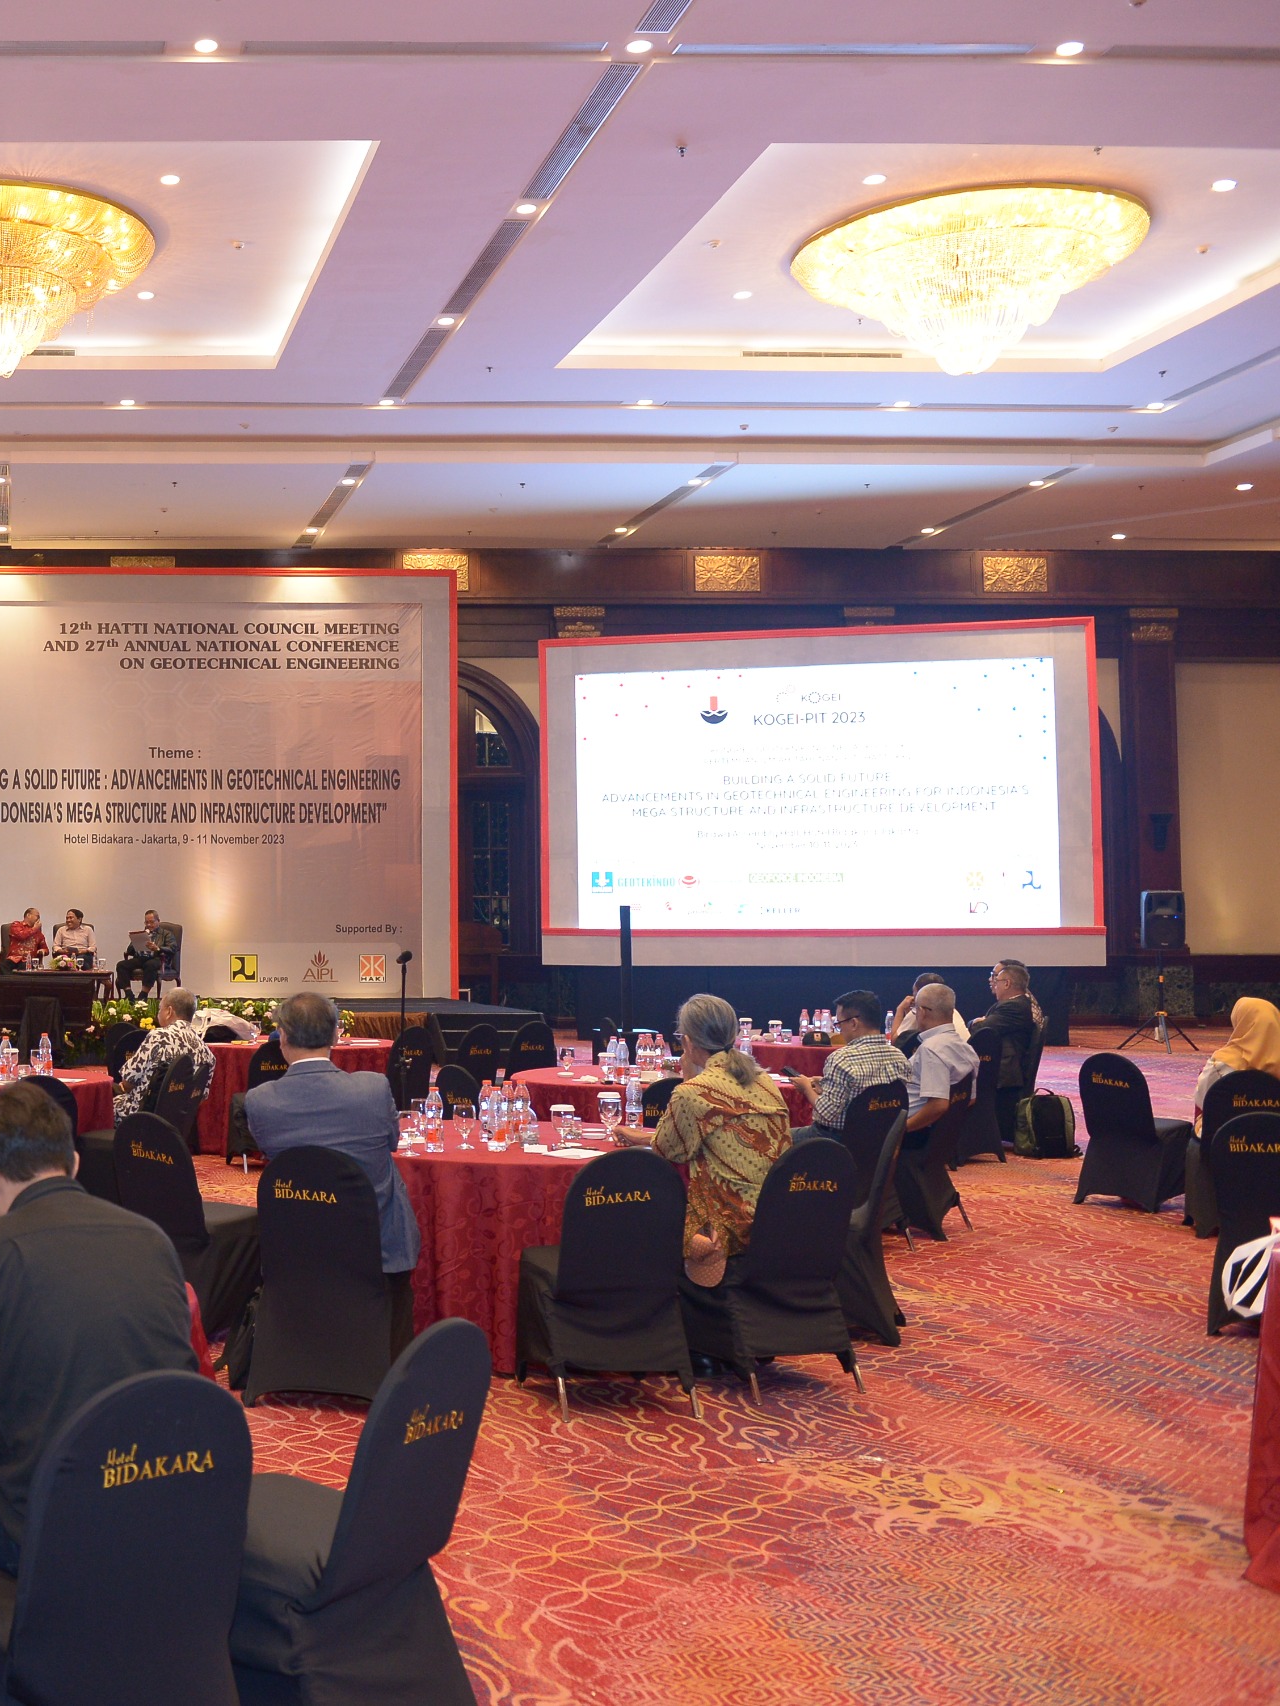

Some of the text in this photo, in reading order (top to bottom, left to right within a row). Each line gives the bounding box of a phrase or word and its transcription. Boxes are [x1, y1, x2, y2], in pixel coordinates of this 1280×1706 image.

[59, 621, 399, 635] 12th HATTI NATIONAL COUNCIL MEETING
[43, 639, 399, 652] AND 27th ANNUAL NATIONAL CONFERENCE
[119, 657, 400, 670] ON GEOTECHNICAL ENGINEERING
[753, 710, 866, 726] KOGEI-PIT 2023
[149, 747, 193, 759] Theme
[13, 769, 21, 790] A
[24, 769, 58, 790] SOLID
[62, 769, 100, 790] FUTURE
[111, 769, 207, 790] ADVANCEMENTS
[211, 769, 223, 790] IN
[227, 769, 318, 790] GEOTECHNICAL
[321, 769, 401, 790] ENGINEERING
[723, 774, 782, 785] BUILDING
[602, 791, 703, 803] ADVANCEMENTS
[66, 802, 101, 824] MEGA
[105, 802, 167, 824] STRUCTURE
[171, 802, 196, 824] AND
[200, 802, 295, 824] INFRASTRUCTURE
[632, 807, 666, 818] MEGA
[64, 834, 285, 847] Hotel Bidakara Jakarta, 9 11 November 2023
[335, 924, 397, 935] Supported By
[303, 968, 333, 980] AIPI
[1092, 1077, 1130, 1089] BIDAKARA
[1230, 1142, 1280, 1154] BIDAKAR
[132, 1148, 174, 1165] BIDAKARA
[273, 1178, 293, 1190] Hotel
[789, 1180, 838, 1192] BIDAKARA
[275, 1188, 337, 1204] BIDAKARA
[582, 1185, 605, 1197] Hotel
[585, 1190, 651, 1207] BIDAKARA
[404, 1410, 464, 1445] BIDAKARA
[99, 1442, 138, 1471] Hotel
[103, 1449, 214, 1489] BIDAKARA
